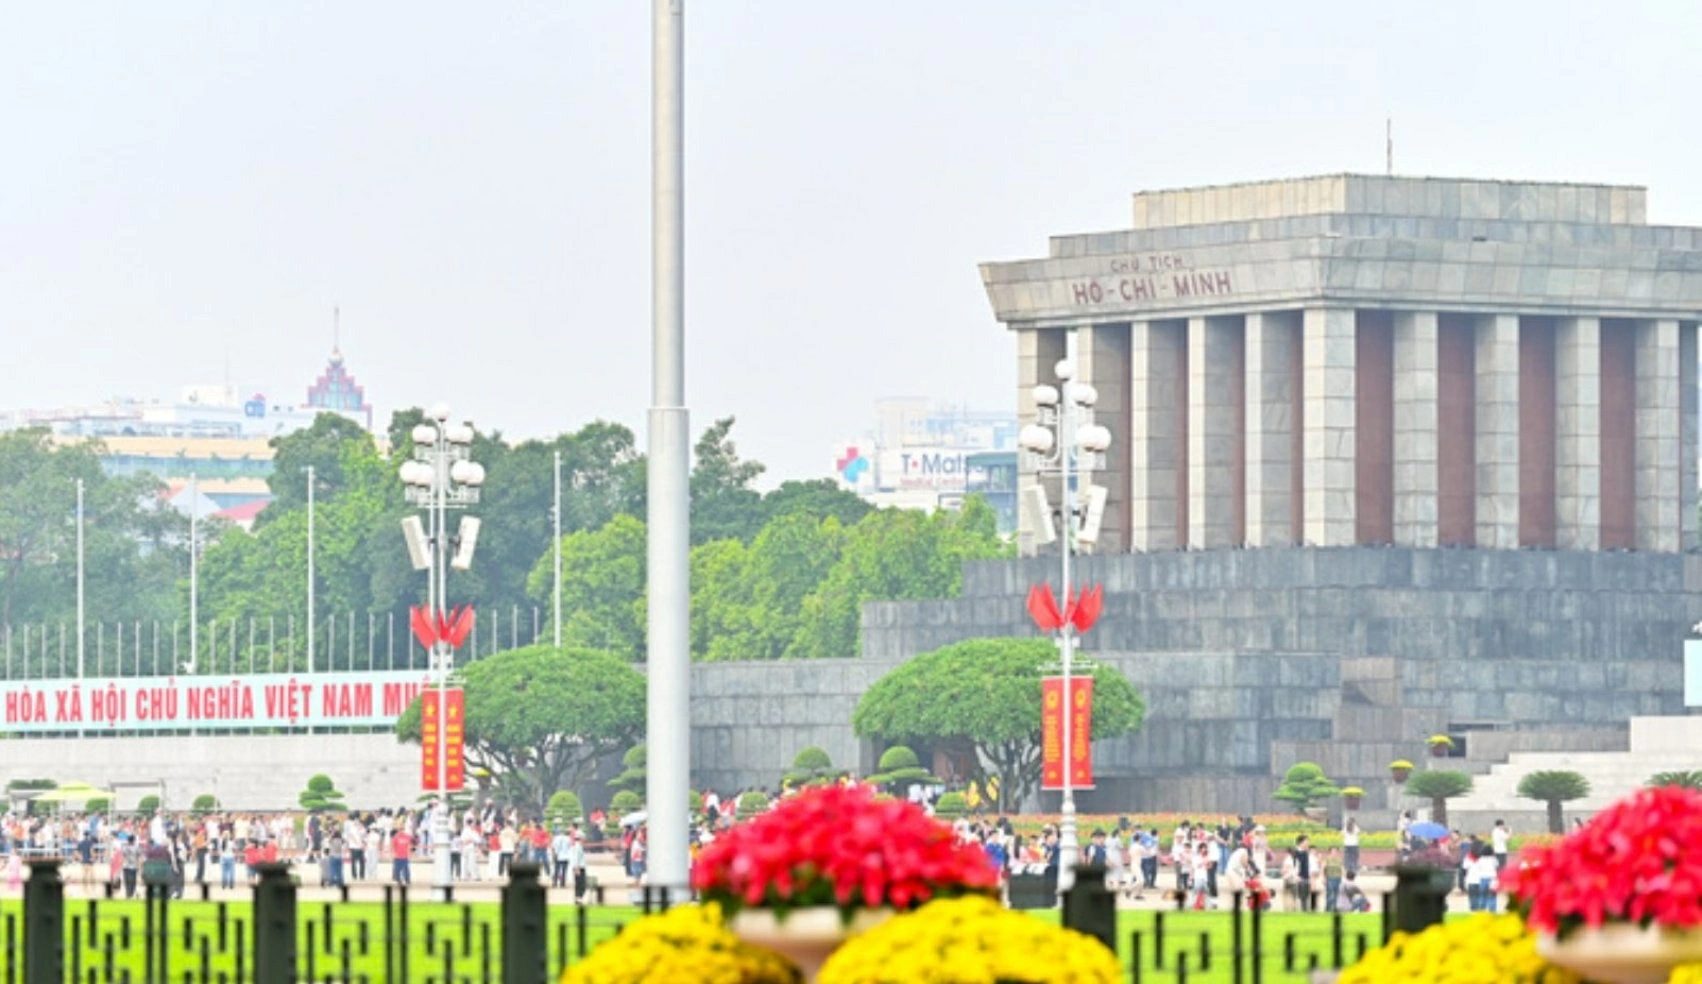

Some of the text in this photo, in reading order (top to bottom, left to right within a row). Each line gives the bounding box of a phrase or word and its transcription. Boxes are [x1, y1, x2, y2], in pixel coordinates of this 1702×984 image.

[6, 685, 47, 723] HÒA
[55, 684, 83, 722] XÃ
[91, 682, 126, 727] HỘI
[135, 676, 178, 720] CHỦ
[187, 680, 254, 720] NGHĨA
[264, 677, 313, 724] VIỆT
[322, 682, 373, 717] NAM
